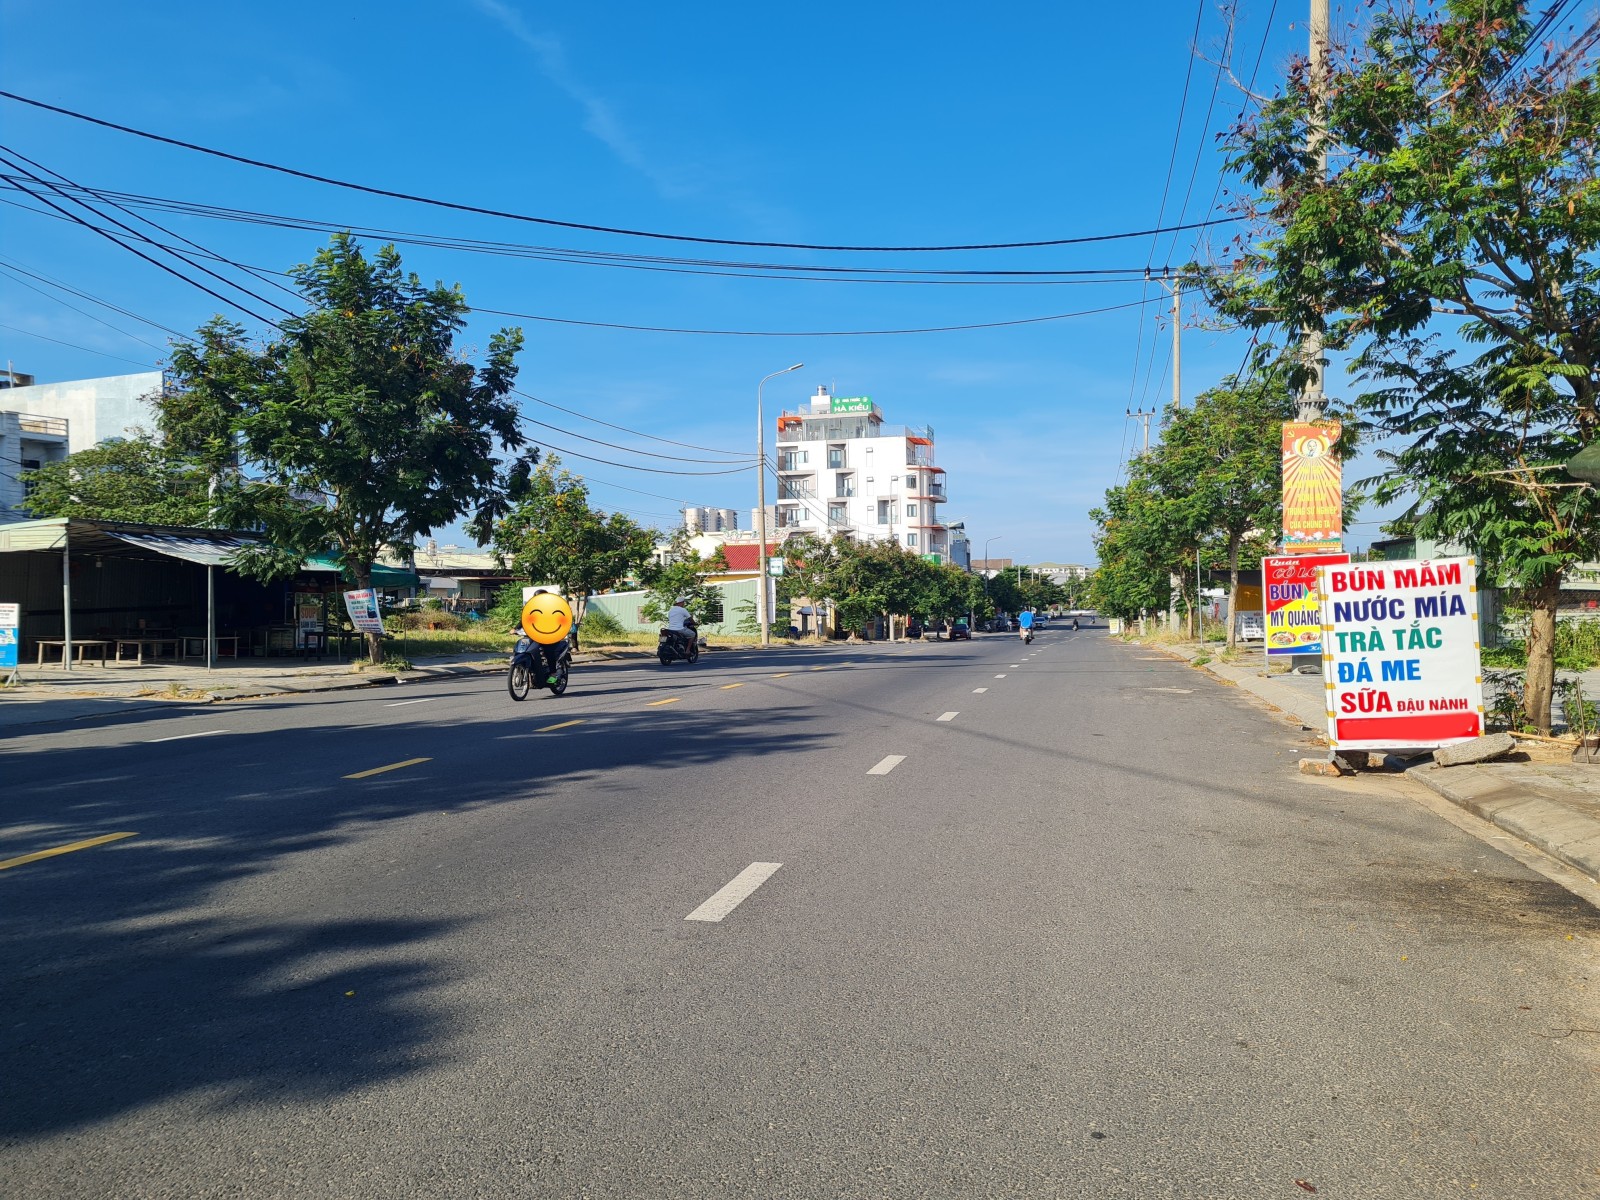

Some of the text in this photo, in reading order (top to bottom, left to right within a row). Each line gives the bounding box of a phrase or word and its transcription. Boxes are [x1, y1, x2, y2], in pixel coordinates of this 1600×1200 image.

[1331, 559, 1462, 593] BÚN MẮM
[1269, 580, 1302, 600] BÚN
[1288, 604, 1320, 628] QUẢNG
[1333, 590, 1466, 623] NƯỚC MÍA
[1335, 620, 1443, 653] TRÀ TẮC
[1337, 656, 1422, 683] ĐÁ ME
[1340, 687, 1468, 714] SỮA ĐẬU NÀNH
